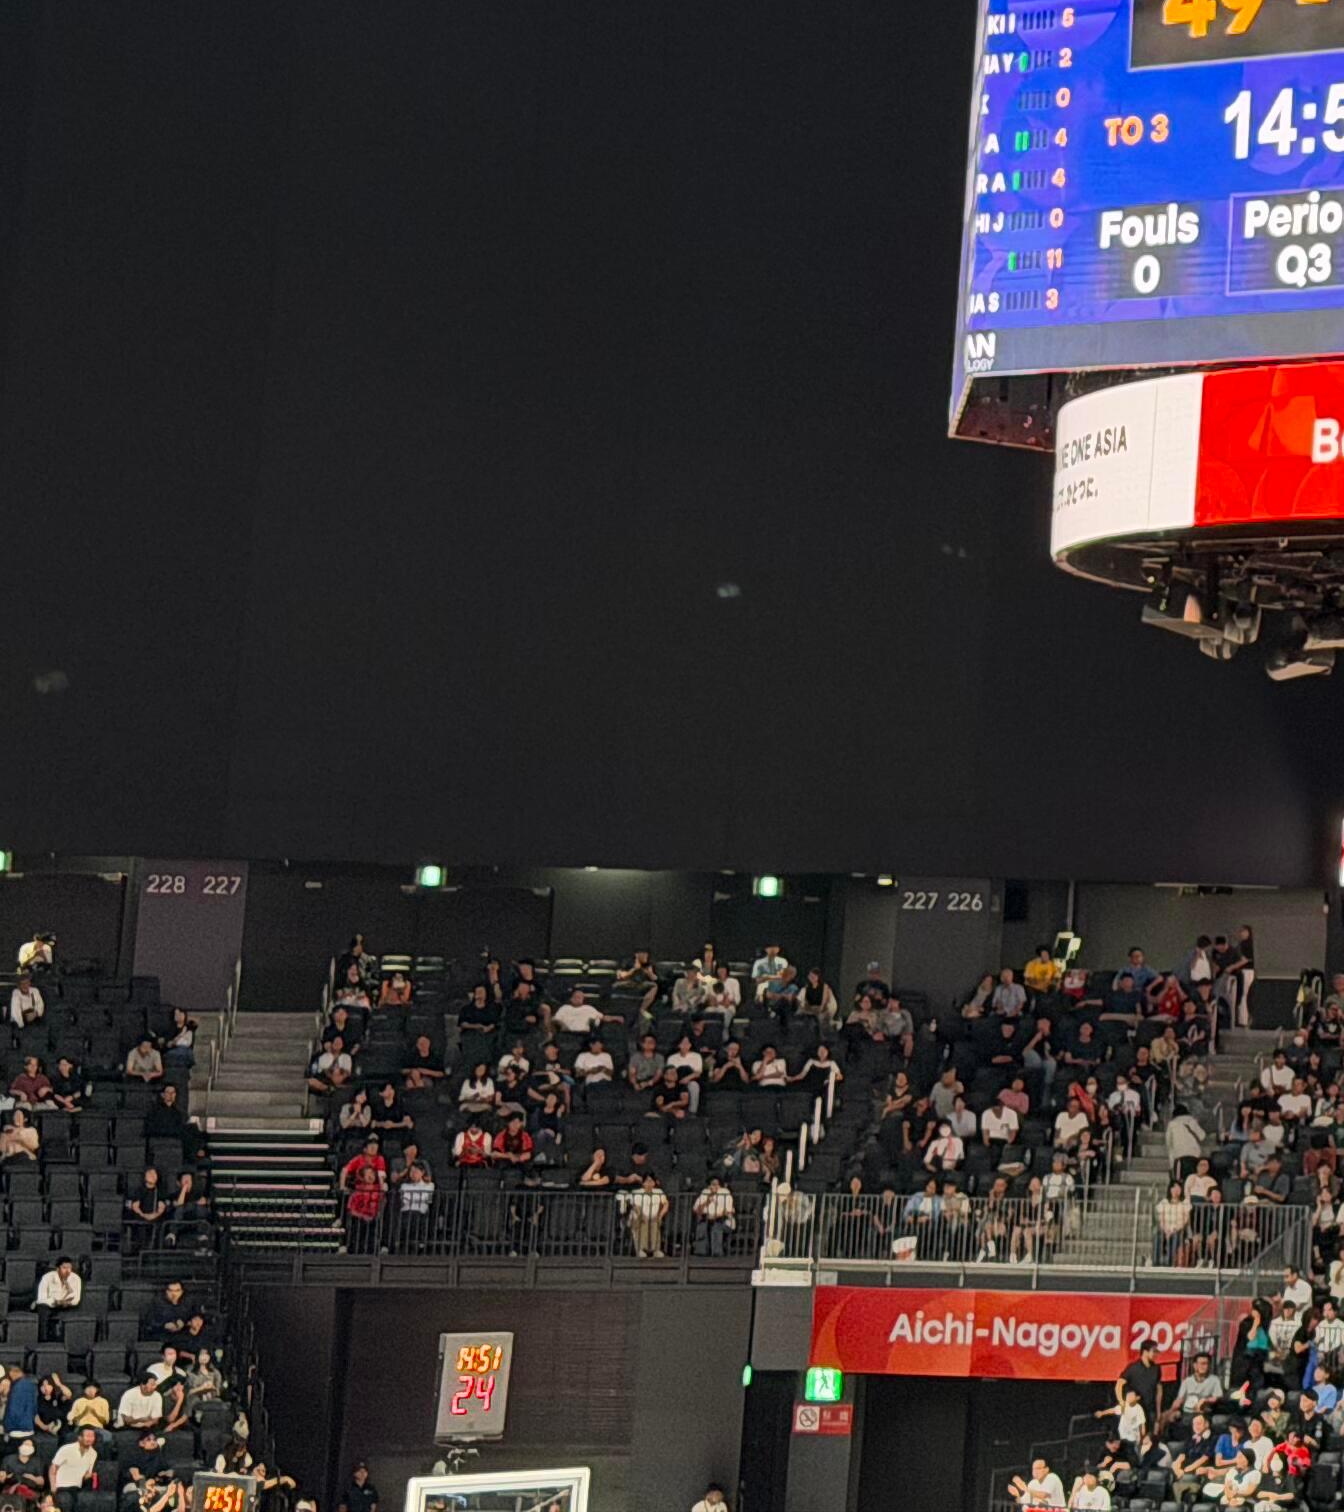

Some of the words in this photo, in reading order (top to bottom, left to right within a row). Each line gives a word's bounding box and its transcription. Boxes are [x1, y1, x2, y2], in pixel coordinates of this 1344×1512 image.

[1105, 118, 1142, 146] TO
[1150, 114, 1169, 142] 3
[1100, 203, 1200, 248] Fouls
[1133, 254, 1160, 293] 0
[1276, 243, 1331, 286] Q3
[1094, 425, 1127, 459] ASIA
[147, 874, 186, 895] 228
[202, 875, 241, 896] 227
[902, 892, 938, 909] 227
[947, 893, 983, 911] 226
[889, 1309, 1121, 1358] Aichi-Nagoya
[451, 1376, 495, 1414] 24
